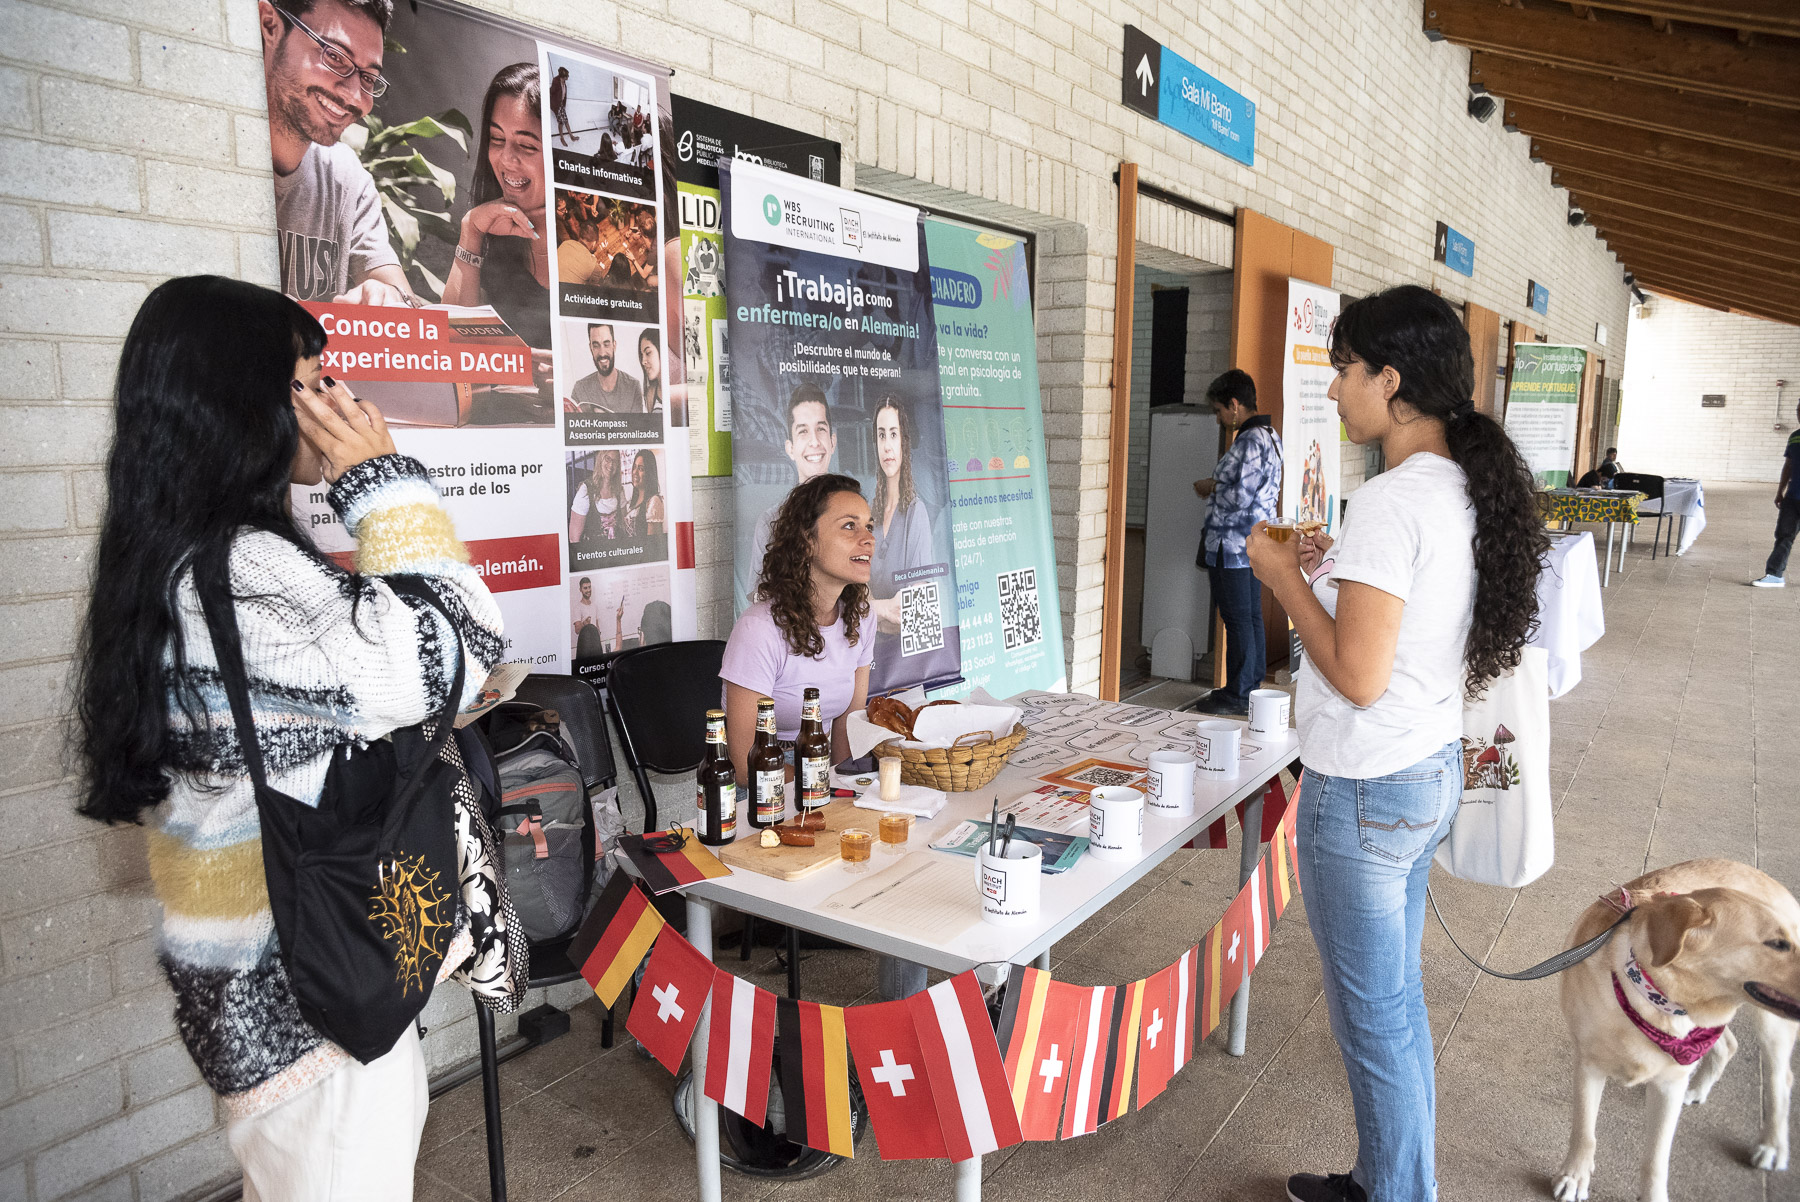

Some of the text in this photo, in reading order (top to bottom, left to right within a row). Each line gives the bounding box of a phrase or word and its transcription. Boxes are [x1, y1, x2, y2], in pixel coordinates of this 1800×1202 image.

[1182, 76, 1200, 106] Sala
[1201, 87, 1210, 111] Mi
[1211, 93, 1232, 123] Barrio
[696, 134, 715, 144] SISTEMA
[696, 142, 724, 154] BIBLIOTECAS
[764, 158, 787, 168] BIBLIOTECA
[558, 159, 643, 186] Charlas informativas
[682, 196, 722, 228] LID
[784, 200, 801, 212] WBS
[786, 213, 835, 233] RECRUITING
[786, 228, 835, 245] INTERNATIONAL
[776, 270, 893, 312] ¡Trabaja como
[564, 293, 643, 312] Actividades gratuitas
[319, 313, 438, 340] Conoce la
[737, 304, 920, 338] enfermera/o en Alemania!
[940, 322, 988, 339] va la vida?
[794, 342, 891, 361] ¡Descrubre el mundo de
[948, 346, 953, 360] y
[955, 348, 993, 361] conversa
[994, 351, 1009, 361] con
[1011, 352, 1020, 362] un
[460, 352, 524, 373] DACH!
[779, 360, 901, 379] posibilidades que te esperan!
[939, 364, 1022, 382] onal en psicología de
[946, 384, 982, 399] gratuita.
[1511, 382, 1540, 392] APRENDE
[569, 420, 628, 428] DACH-Kompass:
[569, 430, 659, 440] Asesorías personalizadas
[428, 462, 543, 479] estro idioma por
[470, 482, 486, 495] de
[491, 482, 510, 494] los
[958, 493, 982, 507] donde
[984, 495, 997, 505] nos
[952, 516, 1012, 533] cate con nuestras
[977, 534, 986, 546] de
[988, 530, 1016, 544] atención
[577, 545, 643, 561] Eventos culturales
[960, 552, 984, 570] (24/7).
[476, 555, 544, 577] alemán.
[894, 573, 907, 582] Beca
[972, 616, 982, 628] 44
[984, 632, 993, 644] 23
[974, 650, 996, 669] Social
[580, 662, 605, 674] Cursos
[960, 679, 971, 692] 123
[984, 873, 1002, 884] DACH
